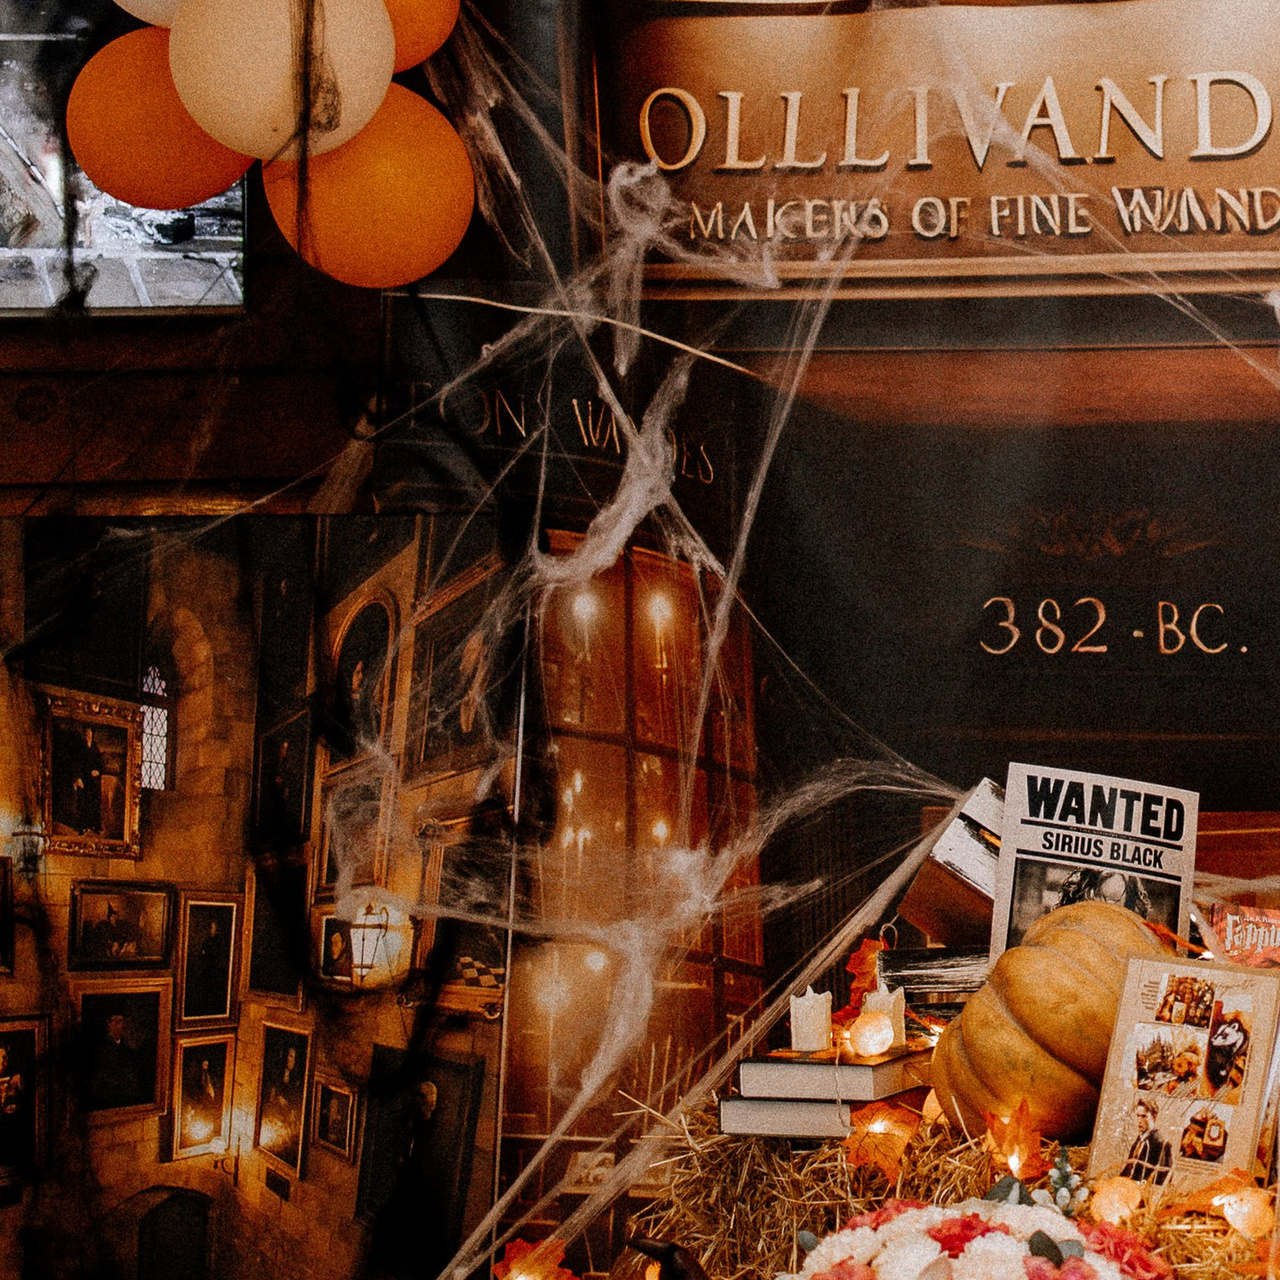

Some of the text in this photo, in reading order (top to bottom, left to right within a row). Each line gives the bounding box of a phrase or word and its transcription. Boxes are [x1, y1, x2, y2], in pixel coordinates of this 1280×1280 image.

[912, 195, 970, 238] OF
[991, 192, 1092, 237] FINE
[1026, 774, 1185, 842] WANTED
[1041, 830, 1104, 858] SIRIUS
[1109, 841, 1164, 870] BLACK
